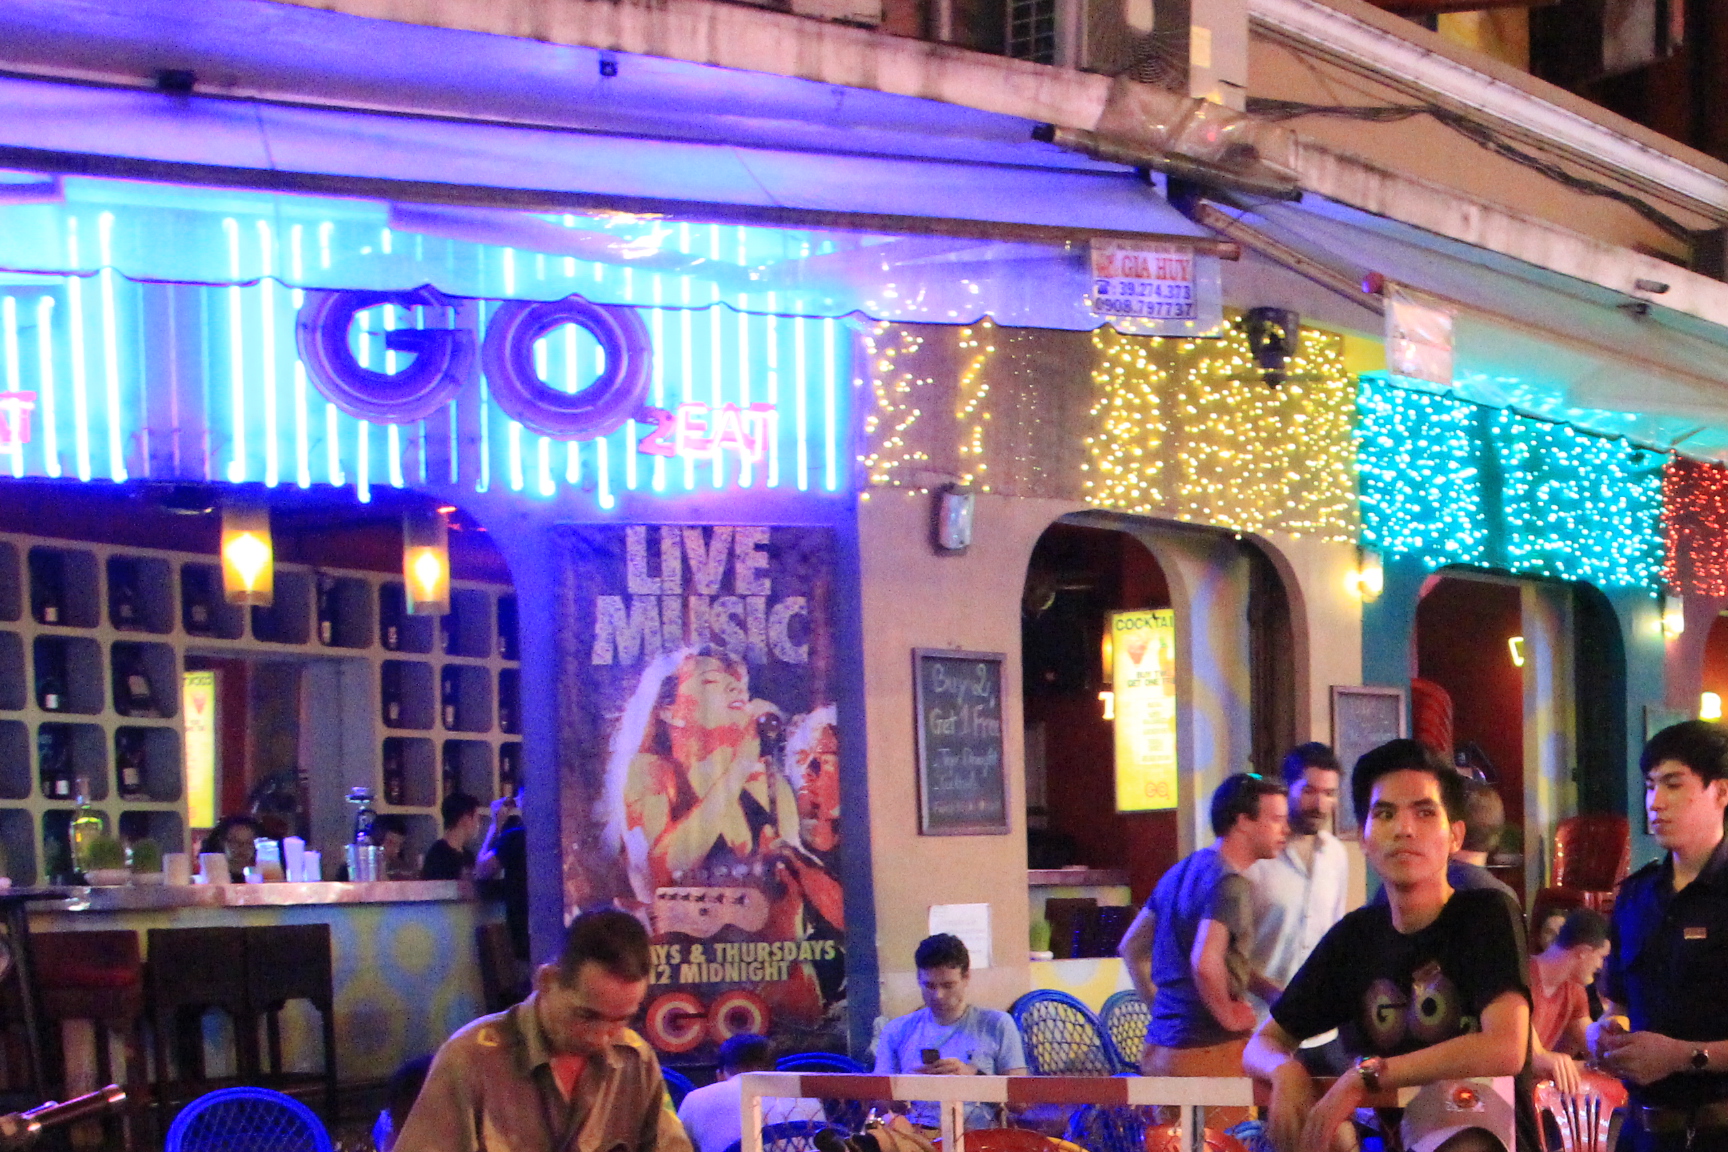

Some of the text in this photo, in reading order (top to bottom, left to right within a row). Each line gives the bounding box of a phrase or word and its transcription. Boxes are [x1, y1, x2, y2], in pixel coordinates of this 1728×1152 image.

[1120, 254, 1191, 281] GIA HUY
[296, 284, 655, 442] GO
[625, 525, 772, 595] LIVE
[592, 595, 809, 666] MUSIC
[931, 663, 967, 705] Buy
[928, 707, 957, 736] Get
[679, 960, 790, 984] MIDNIGHT
[689, 943, 707, 964] &
[713, 939, 836, 963] THURSDAYS
[646, 991, 771, 1053] GO
